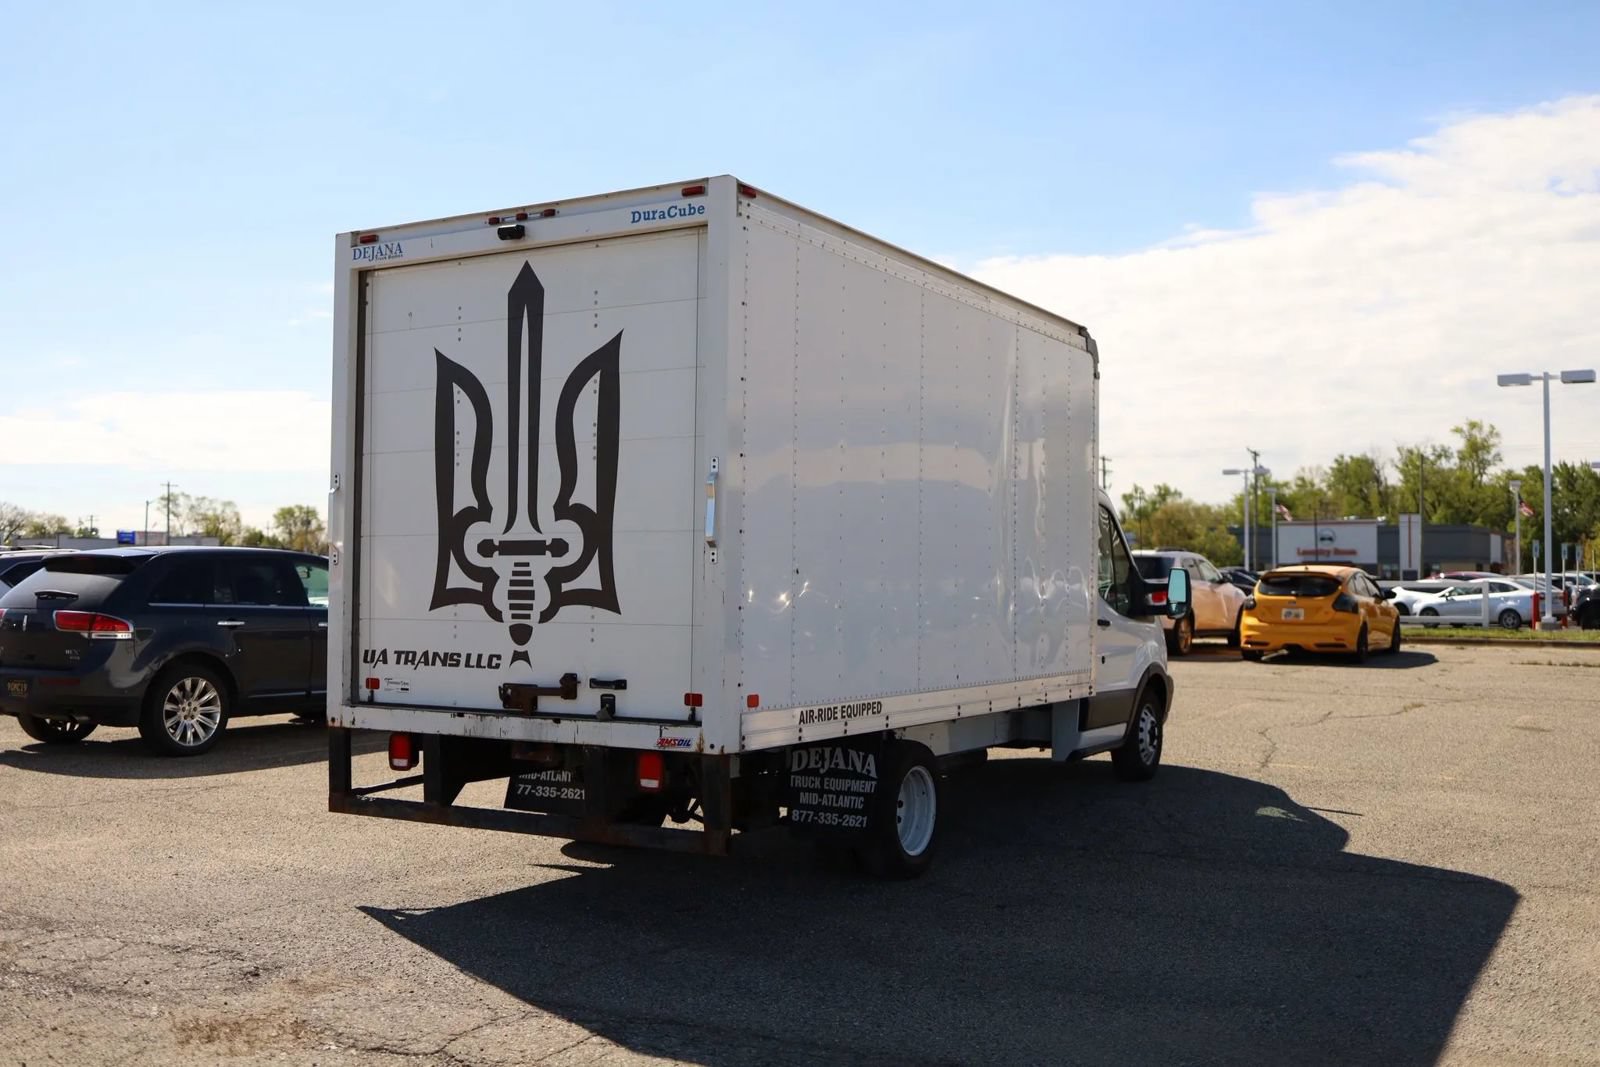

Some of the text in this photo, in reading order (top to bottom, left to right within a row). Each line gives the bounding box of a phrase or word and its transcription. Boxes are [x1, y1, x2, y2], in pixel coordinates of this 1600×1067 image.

[631, 203, 705, 224] DuraCube
[352, 242, 403, 261] DEJANA
[362, 648, 502, 670] UA TRANS LLC
[798, 701, 882, 725] AIR-RIDE EQUIPPED
[791, 747, 878, 779] DEJANA
[790, 775, 877, 793] TRUCK EQUIPMENT
[800, 792, 864, 809] MID-ATLANTIC
[791, 809, 868, 828] 877-335-2621
